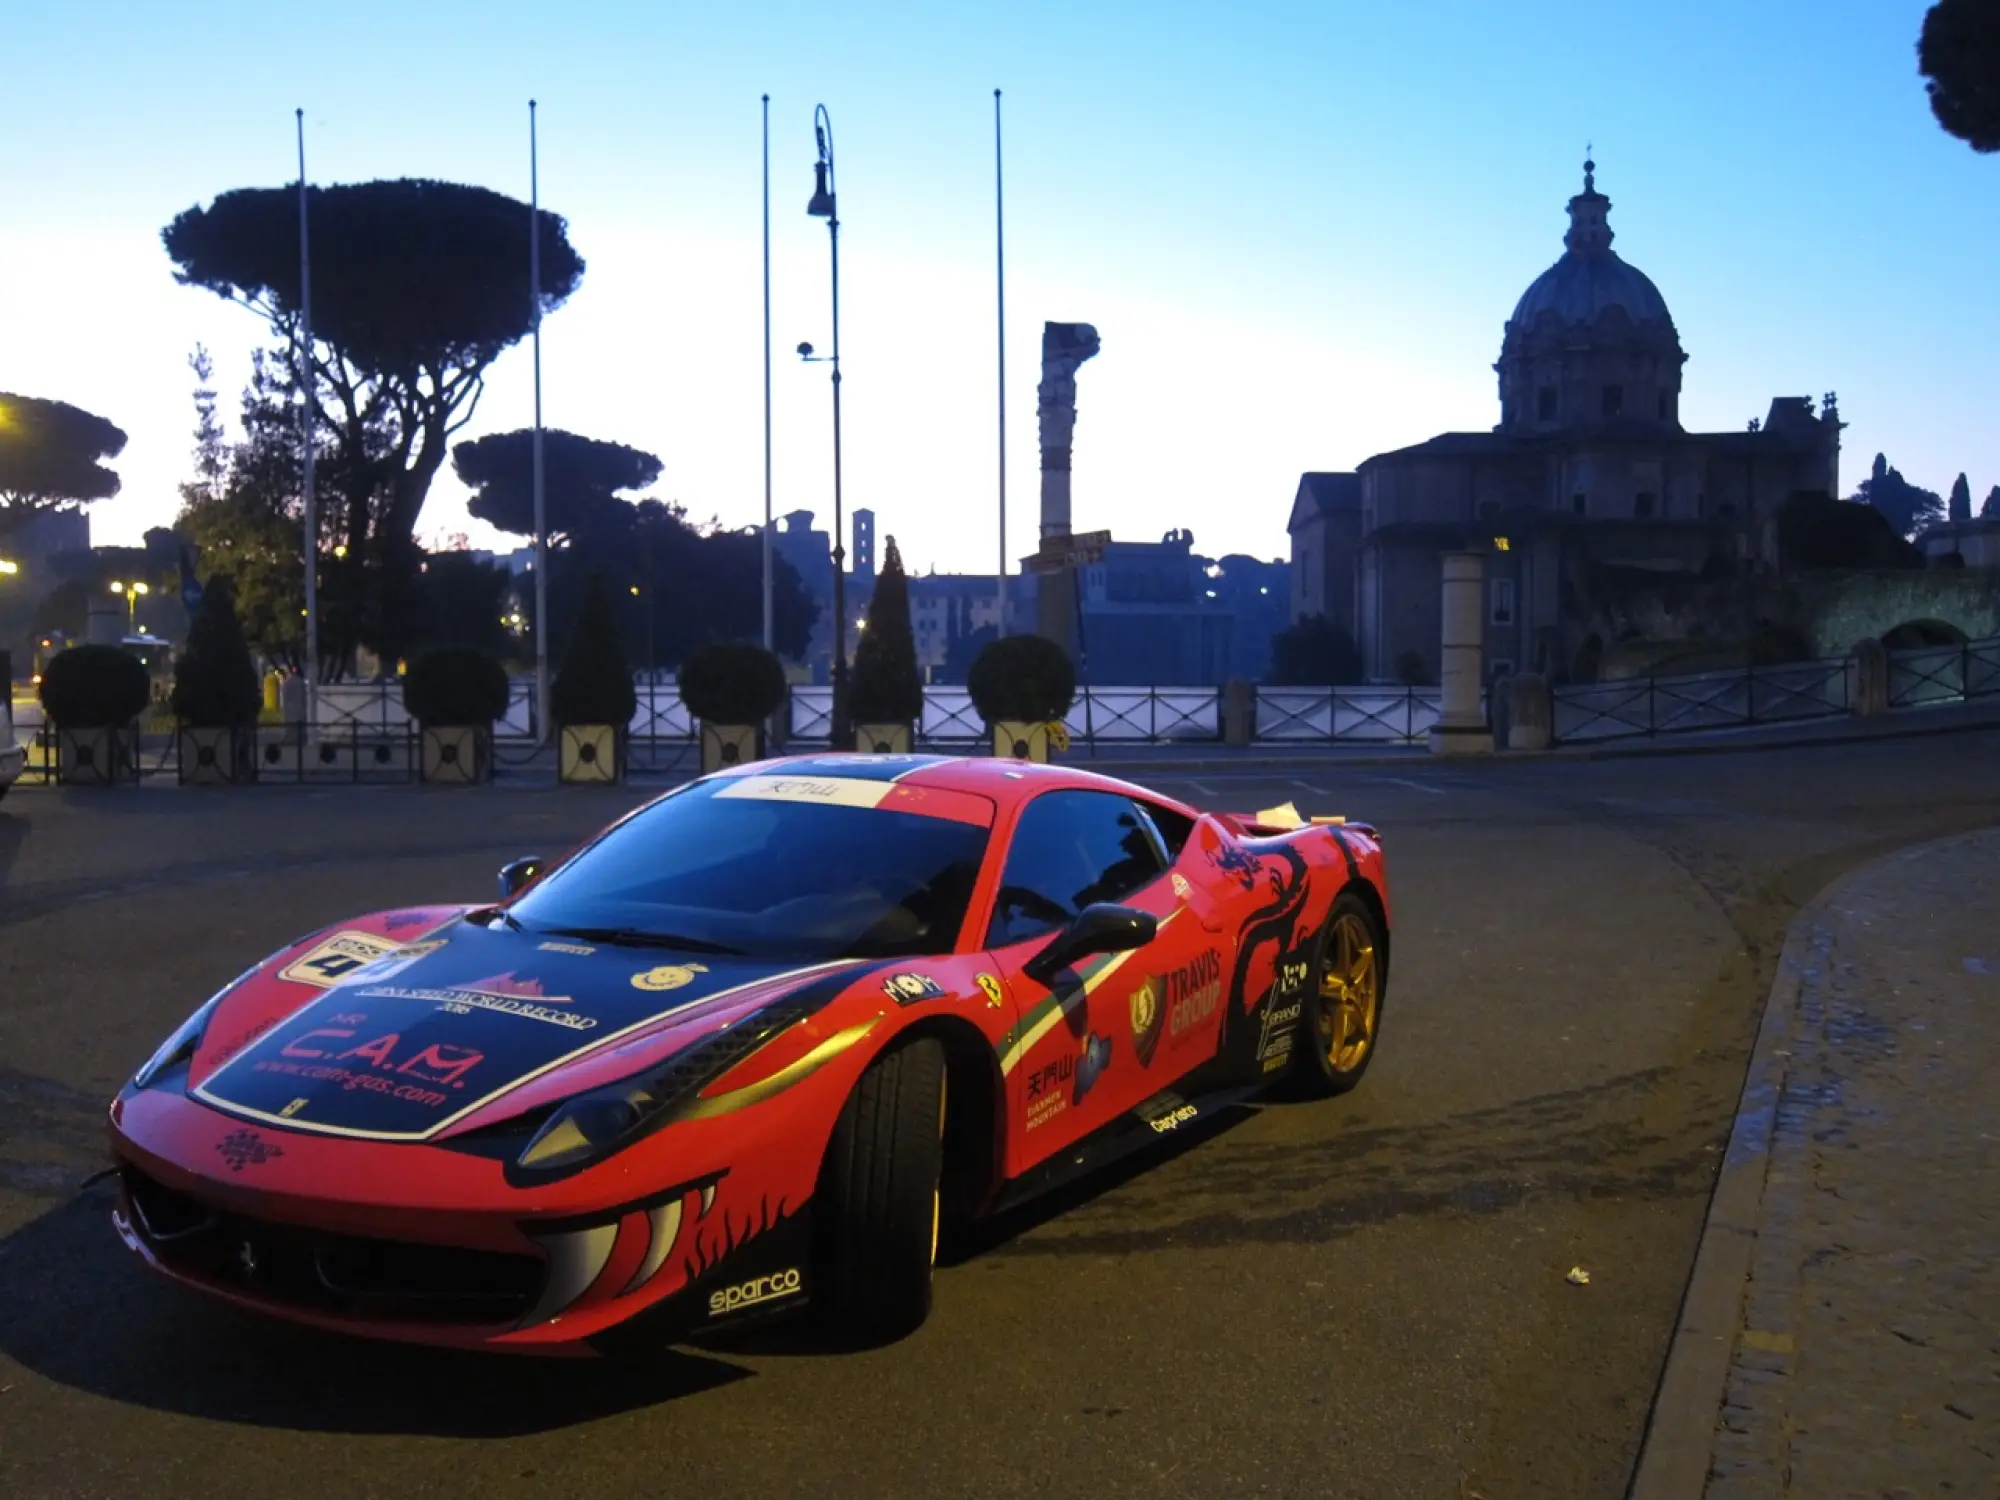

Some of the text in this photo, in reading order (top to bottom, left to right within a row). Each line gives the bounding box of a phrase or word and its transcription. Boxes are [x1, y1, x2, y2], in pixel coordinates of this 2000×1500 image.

[1169, 947, 1221, 1006] TRAVIS
[455, 990, 520, 1013] WORLD
[518, 1003, 598, 1031] RECORD
[1169, 979, 1221, 1037] GROUP
[708, 1268, 800, 1314] sparco
